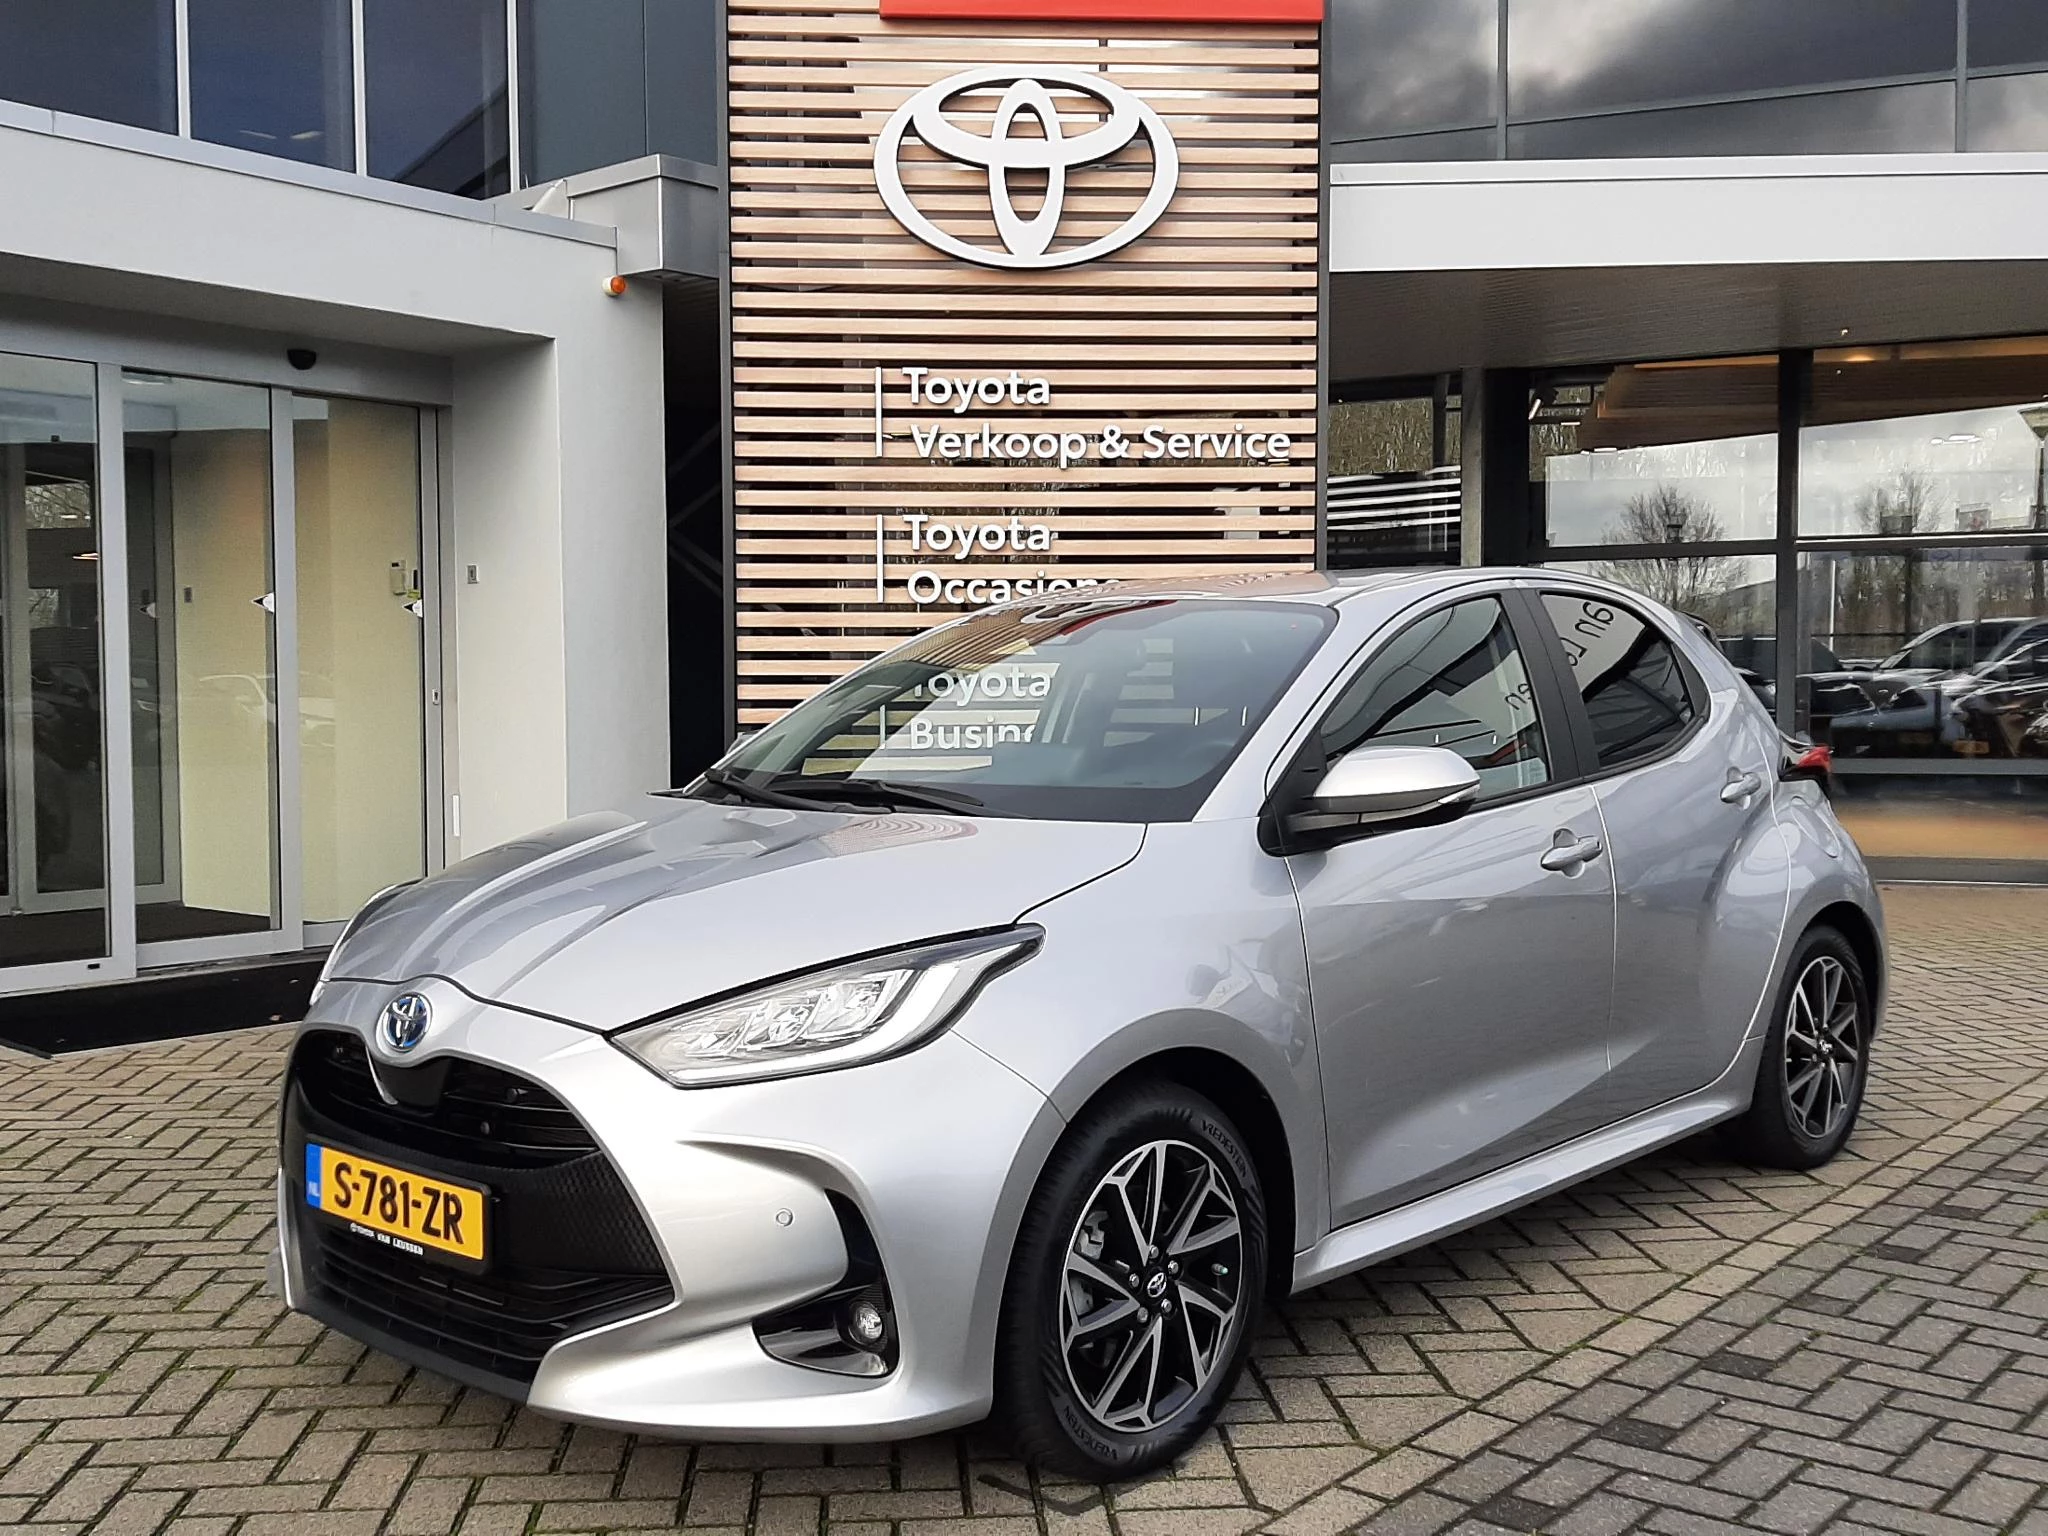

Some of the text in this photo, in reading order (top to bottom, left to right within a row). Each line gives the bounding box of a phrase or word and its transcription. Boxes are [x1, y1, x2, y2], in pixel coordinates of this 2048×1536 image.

[902, 367, 1050, 414] Toyota
[911, 423, 1291, 469] Verkoop & Service
[903, 514, 1050, 560] Toyota
[907, 570, 1120, 604] Occasi
[334, 1161, 464, 1246] S-781-ZR
